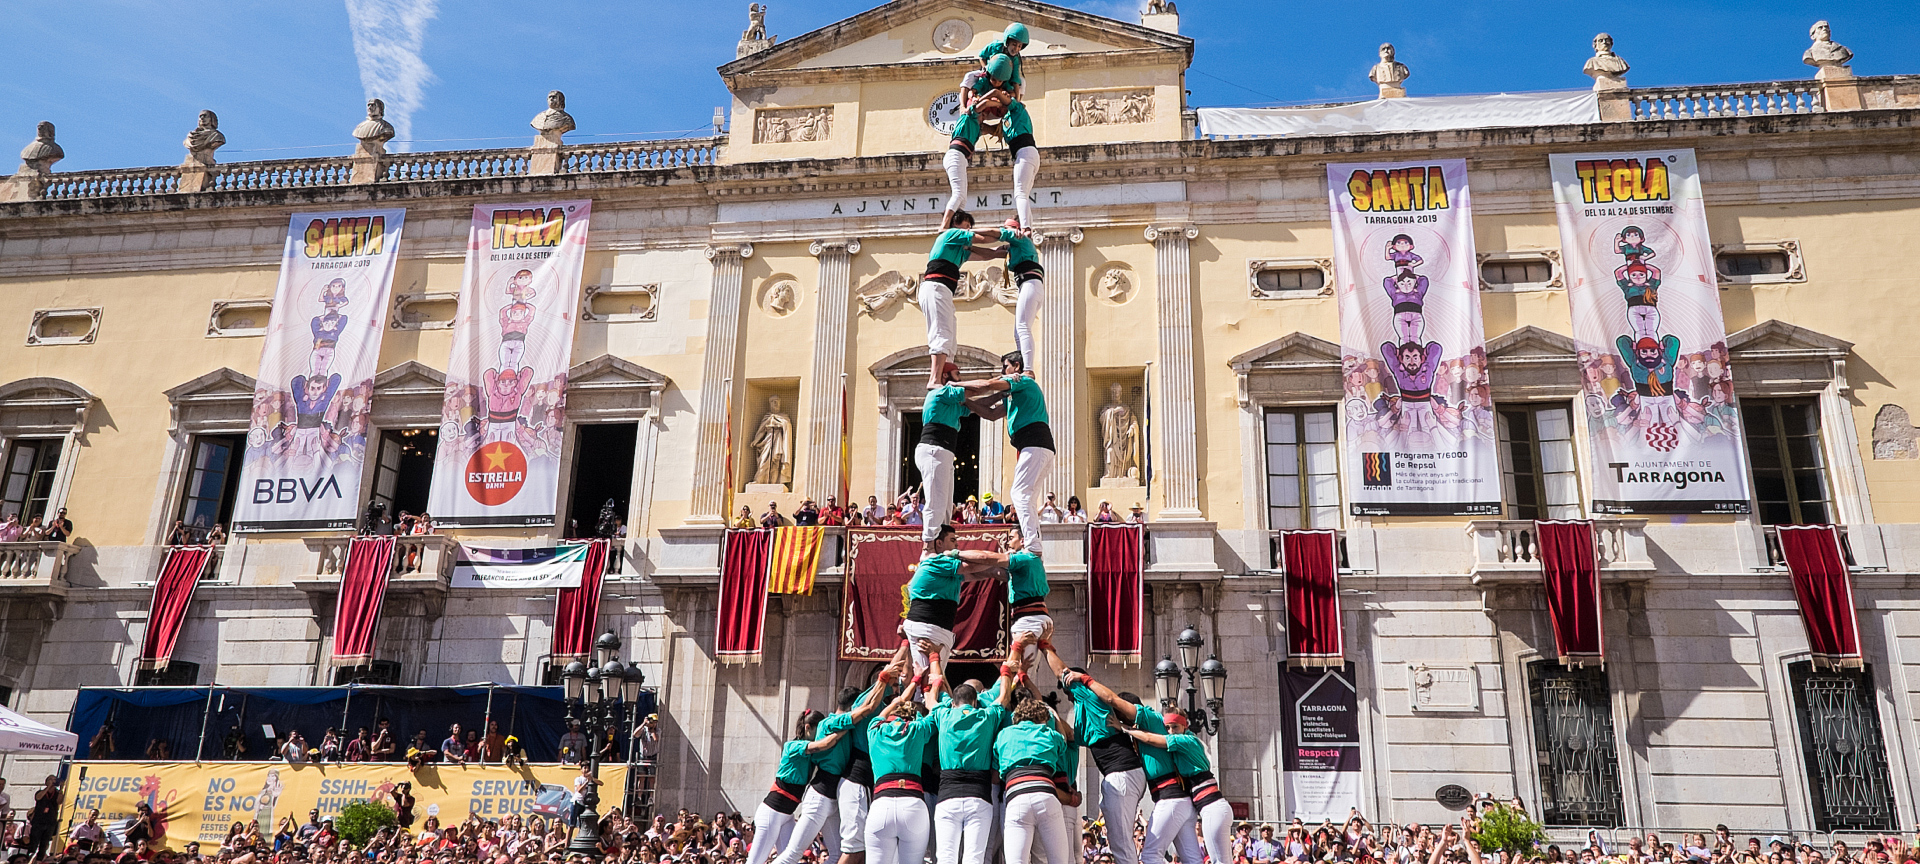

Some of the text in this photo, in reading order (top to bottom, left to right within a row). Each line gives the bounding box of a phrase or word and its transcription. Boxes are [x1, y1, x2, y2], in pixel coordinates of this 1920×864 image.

[1347, 166, 1449, 212] SANTA
[1576, 158, 1670, 204] TECLA
[832, 191, 1061, 214] AJVNTMENT
[1640, 206, 1674, 214] SETEMBRE
[1365, 215, 1437, 224] TARRAGONA 2019
[492, 208, 566, 249] TECLA
[304, 216, 385, 258] SANTA
[311, 261, 352, 269] TARRAGONA
[1394, 452, 1434, 460] Programa
[469, 472, 522, 482] ESTRELLA
[253, 474, 342, 504] BBVA
[19, 742, 74, 752] www.tac12.tv
[1298, 749, 1339, 758] Respecta
[80, 776, 141, 792] SIGUES
[208, 778, 236, 793] NO
[320, 779, 376, 795] SSHH-
[204, 791, 256, 812] ÉS NO
[469, 798, 534, 814] DE BUS
